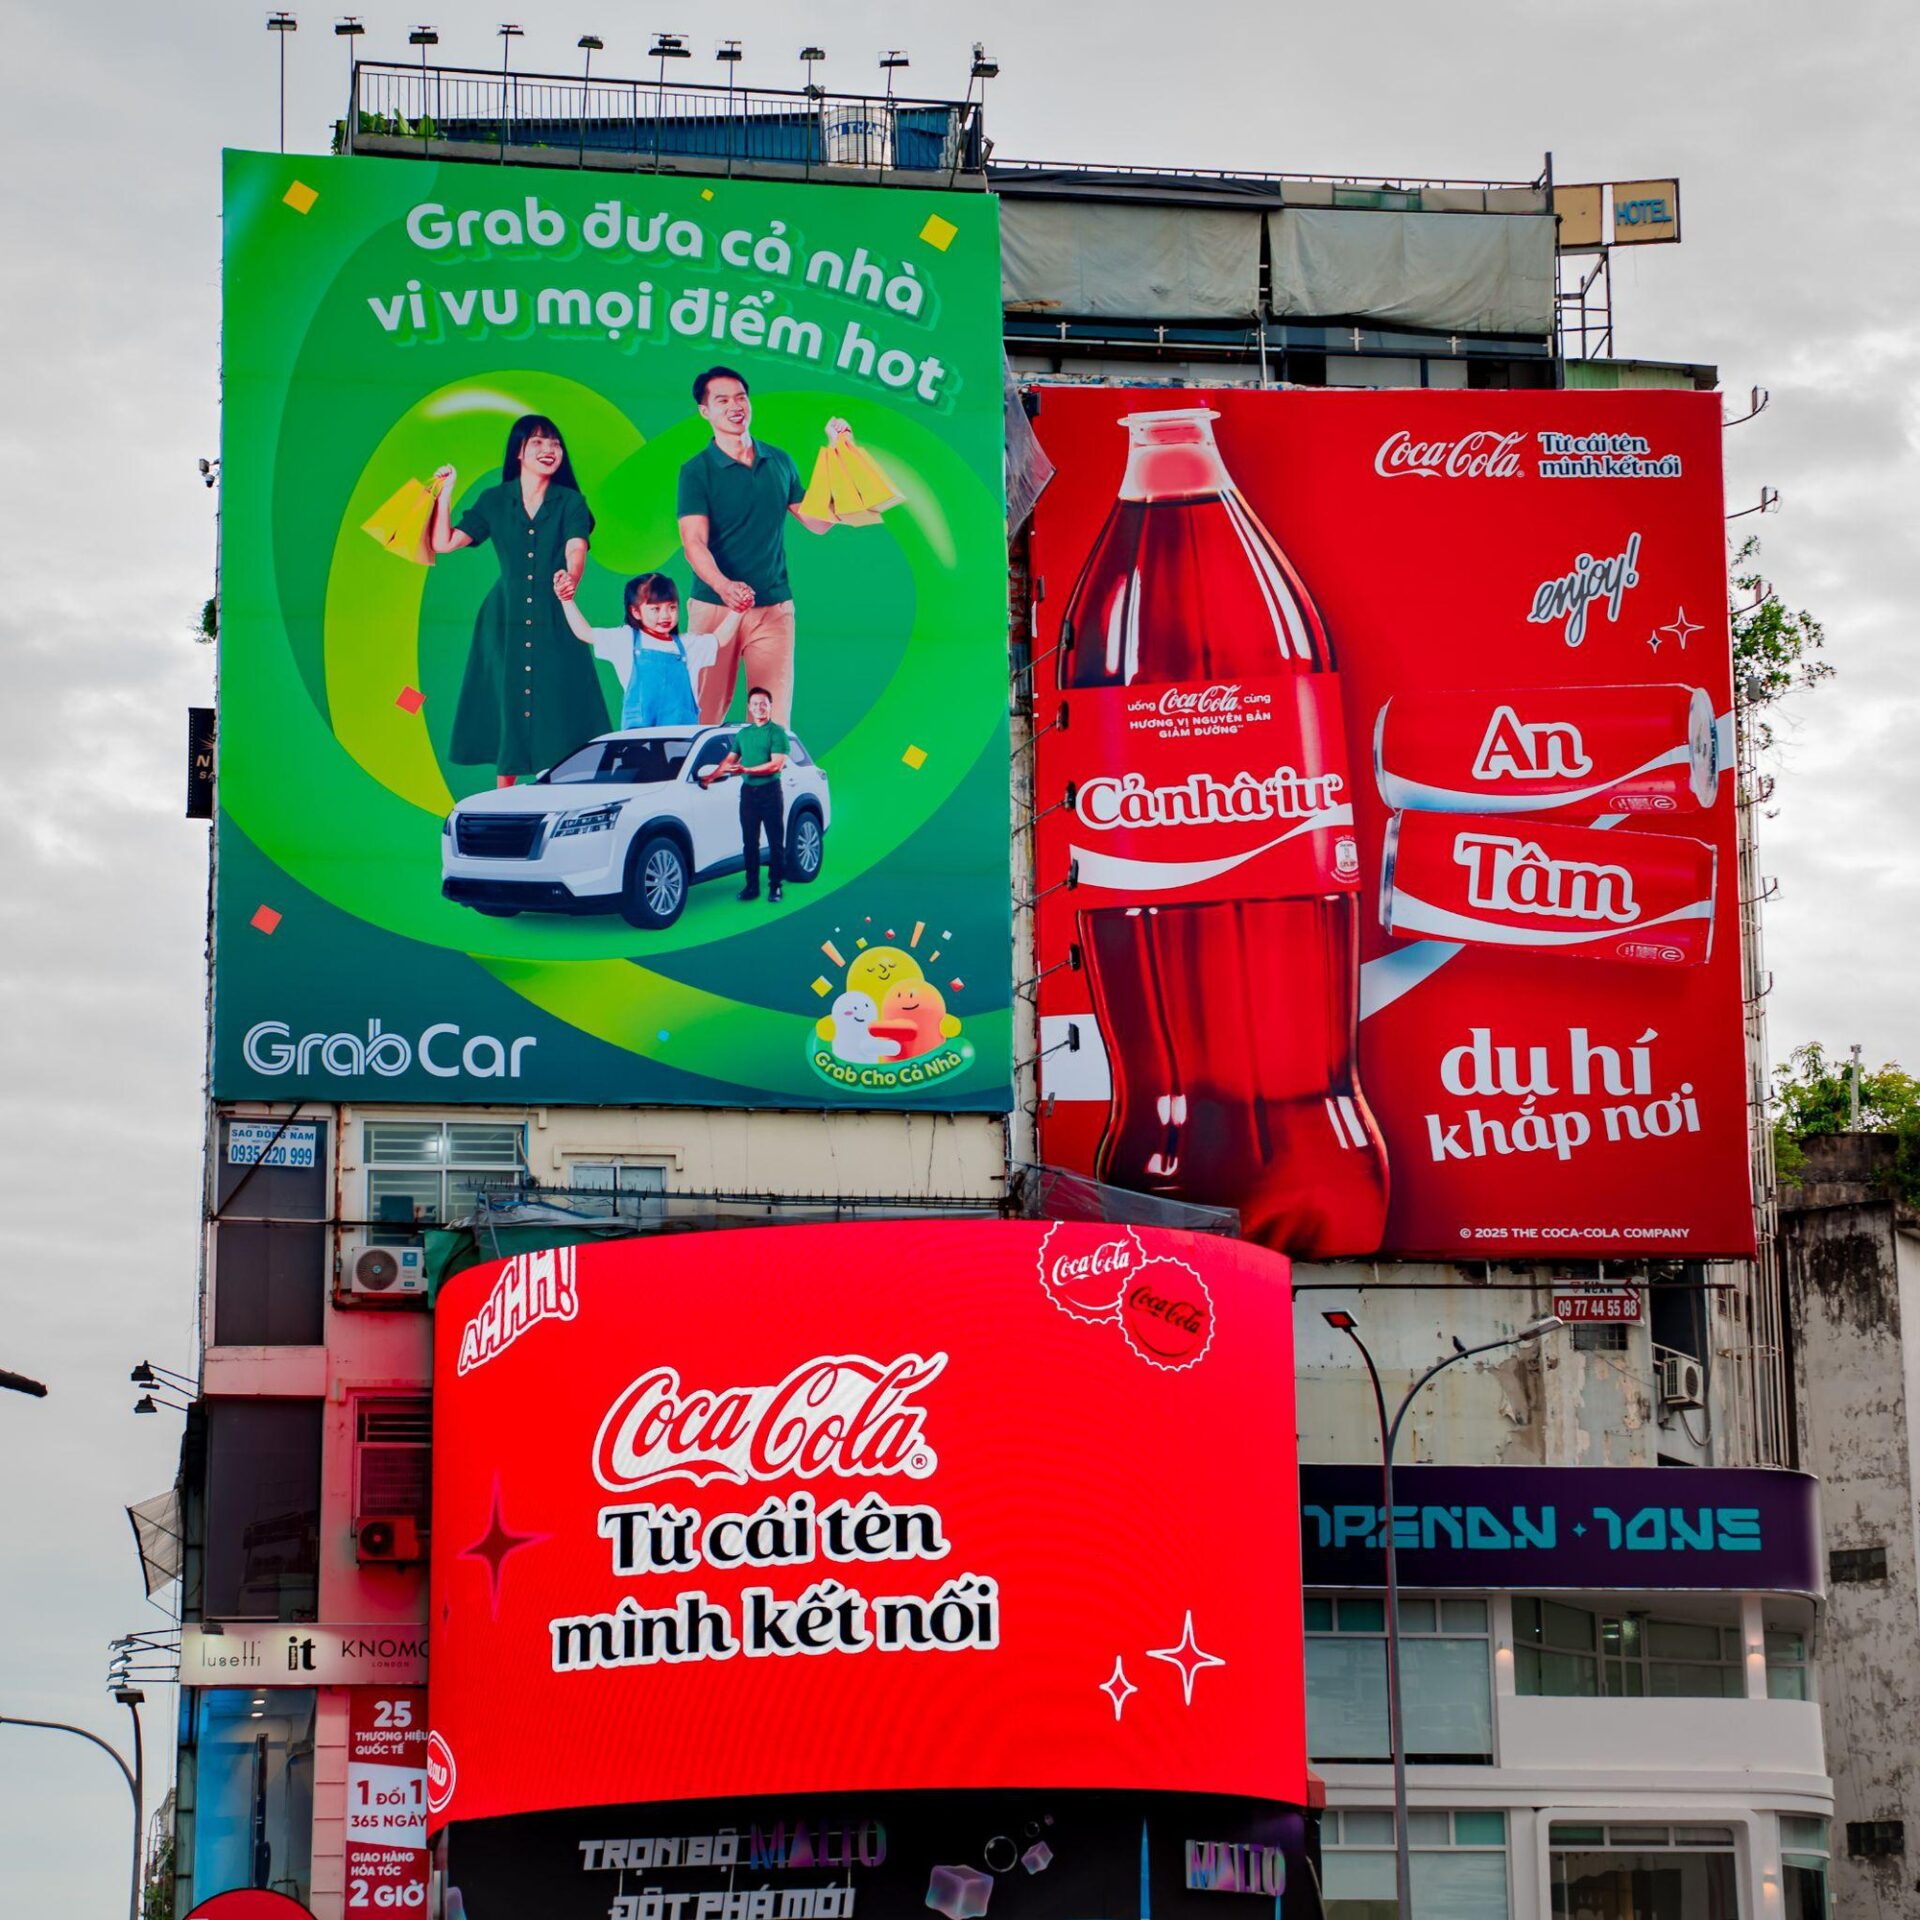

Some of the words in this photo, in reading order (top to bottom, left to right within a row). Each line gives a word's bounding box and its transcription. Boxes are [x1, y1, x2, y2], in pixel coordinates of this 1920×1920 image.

[1615, 199, 1672, 225] HOTEL
[406, 196, 565, 250] Grab
[582, 201, 703, 259] đưa
[720, 220, 791, 275] cả
[805, 246, 925, 318] nhà
[368, 280, 426, 332] vi
[440, 287, 518, 326] vu
[538, 281, 652, 341] mọi
[670, 289, 823, 360] điểm
[836, 320, 945, 401] hot
[1538, 432, 1573, 455] Từ
[1574, 432, 1608, 454] cái
[1609, 433, 1649, 454] tên
[1539, 456, 1604, 478] mình
[1604, 455, 1643, 477] kết
[1643, 455, 1682, 477] nối
[1527, 532, 1641, 647] enjoy!
[1127, 701, 1156, 712] uống
[1244, 693, 1271, 704] cùng
[1130, 717, 1173, 730] HƯƠNG
[1177, 718, 1189, 728] VỊ
[1193, 712, 1242, 725] NGUYÊN
[1246, 709, 1271, 722] BẢN
[1159, 726, 1190, 738] GIẢM
[1472, 705, 1593, 779] An
[1077, 772, 1158, 830] Cả
[1158, 772, 1270, 824] nhà
[1453, 832, 1640, 923] Tâm
[815, 1052, 857, 1083] Grab
[860, 1070, 896, 1085] Cho
[900, 1064, 924, 1083] Cả
[926, 1051, 961, 1077] Nhà
[1440, 1027, 1560, 1096] du
[1568, 1027, 1659, 1096] hí
[231, 1129, 253, 1138] SAO
[290, 1132, 314, 1141] NAM
[1424, 1094, 1591, 1162] khắp
[1601, 1082, 1701, 1141] nơi
[231, 1144, 260, 1163] 0935
[263, 1146, 287, 1164] 220
[290, 1147, 312, 1166] 999
[1474, 1227, 1508, 1239] 2025
[1511, 1228, 1538, 1239] THE
[1541, 1228, 1620, 1239] COCA-COLA
[1622, 1228, 1690, 1239] COMPANY
[1558, 1299, 1572, 1317] 09
[1574, 1299, 1588, 1317] 77
[1591, 1299, 1604, 1317] 44
[1607, 1299, 1620, 1317] 55
[1623, 1299, 1637, 1317] 88
[601, 1499, 705, 1576] Từ
[705, 1490, 816, 1571] cái
[823, 1491, 949, 1561] tên
[550, 1590, 735, 1673] mình
[740, 1580, 871, 1657] kết
[873, 1571, 998, 1652] nối
[288, 1636, 316, 1670] it
[373, 1700, 412, 1728] 25
[355, 1730, 402, 1742] THƯƠNG
[404, 1729, 428, 1743] HIỆU
[355, 1742, 389, 1755] QUỐC
[391, 1741, 405, 1754] TẾ
[357, 1780, 369, 1805] 1
[410, 1779, 422, 1804] 1
[351, 1815, 378, 1828] 365
[384, 1811, 427, 1828] NGÀY
[351, 1852, 380, 1863] GIAO
[382, 1850, 415, 1863] HÀNG
[579, 1838, 680, 1876] TRỌN
[685, 1827, 739, 1873] BỘ
[750, 1819, 887, 1869] MALTO
[377, 1862, 401, 1876] TỐC
[1186, 1839, 1286, 1896] MALTO
[349, 1879, 369, 1907] 2
[374, 1879, 424, 1907] GIỜ
[697, 1884, 776, 1920] PHÁ
